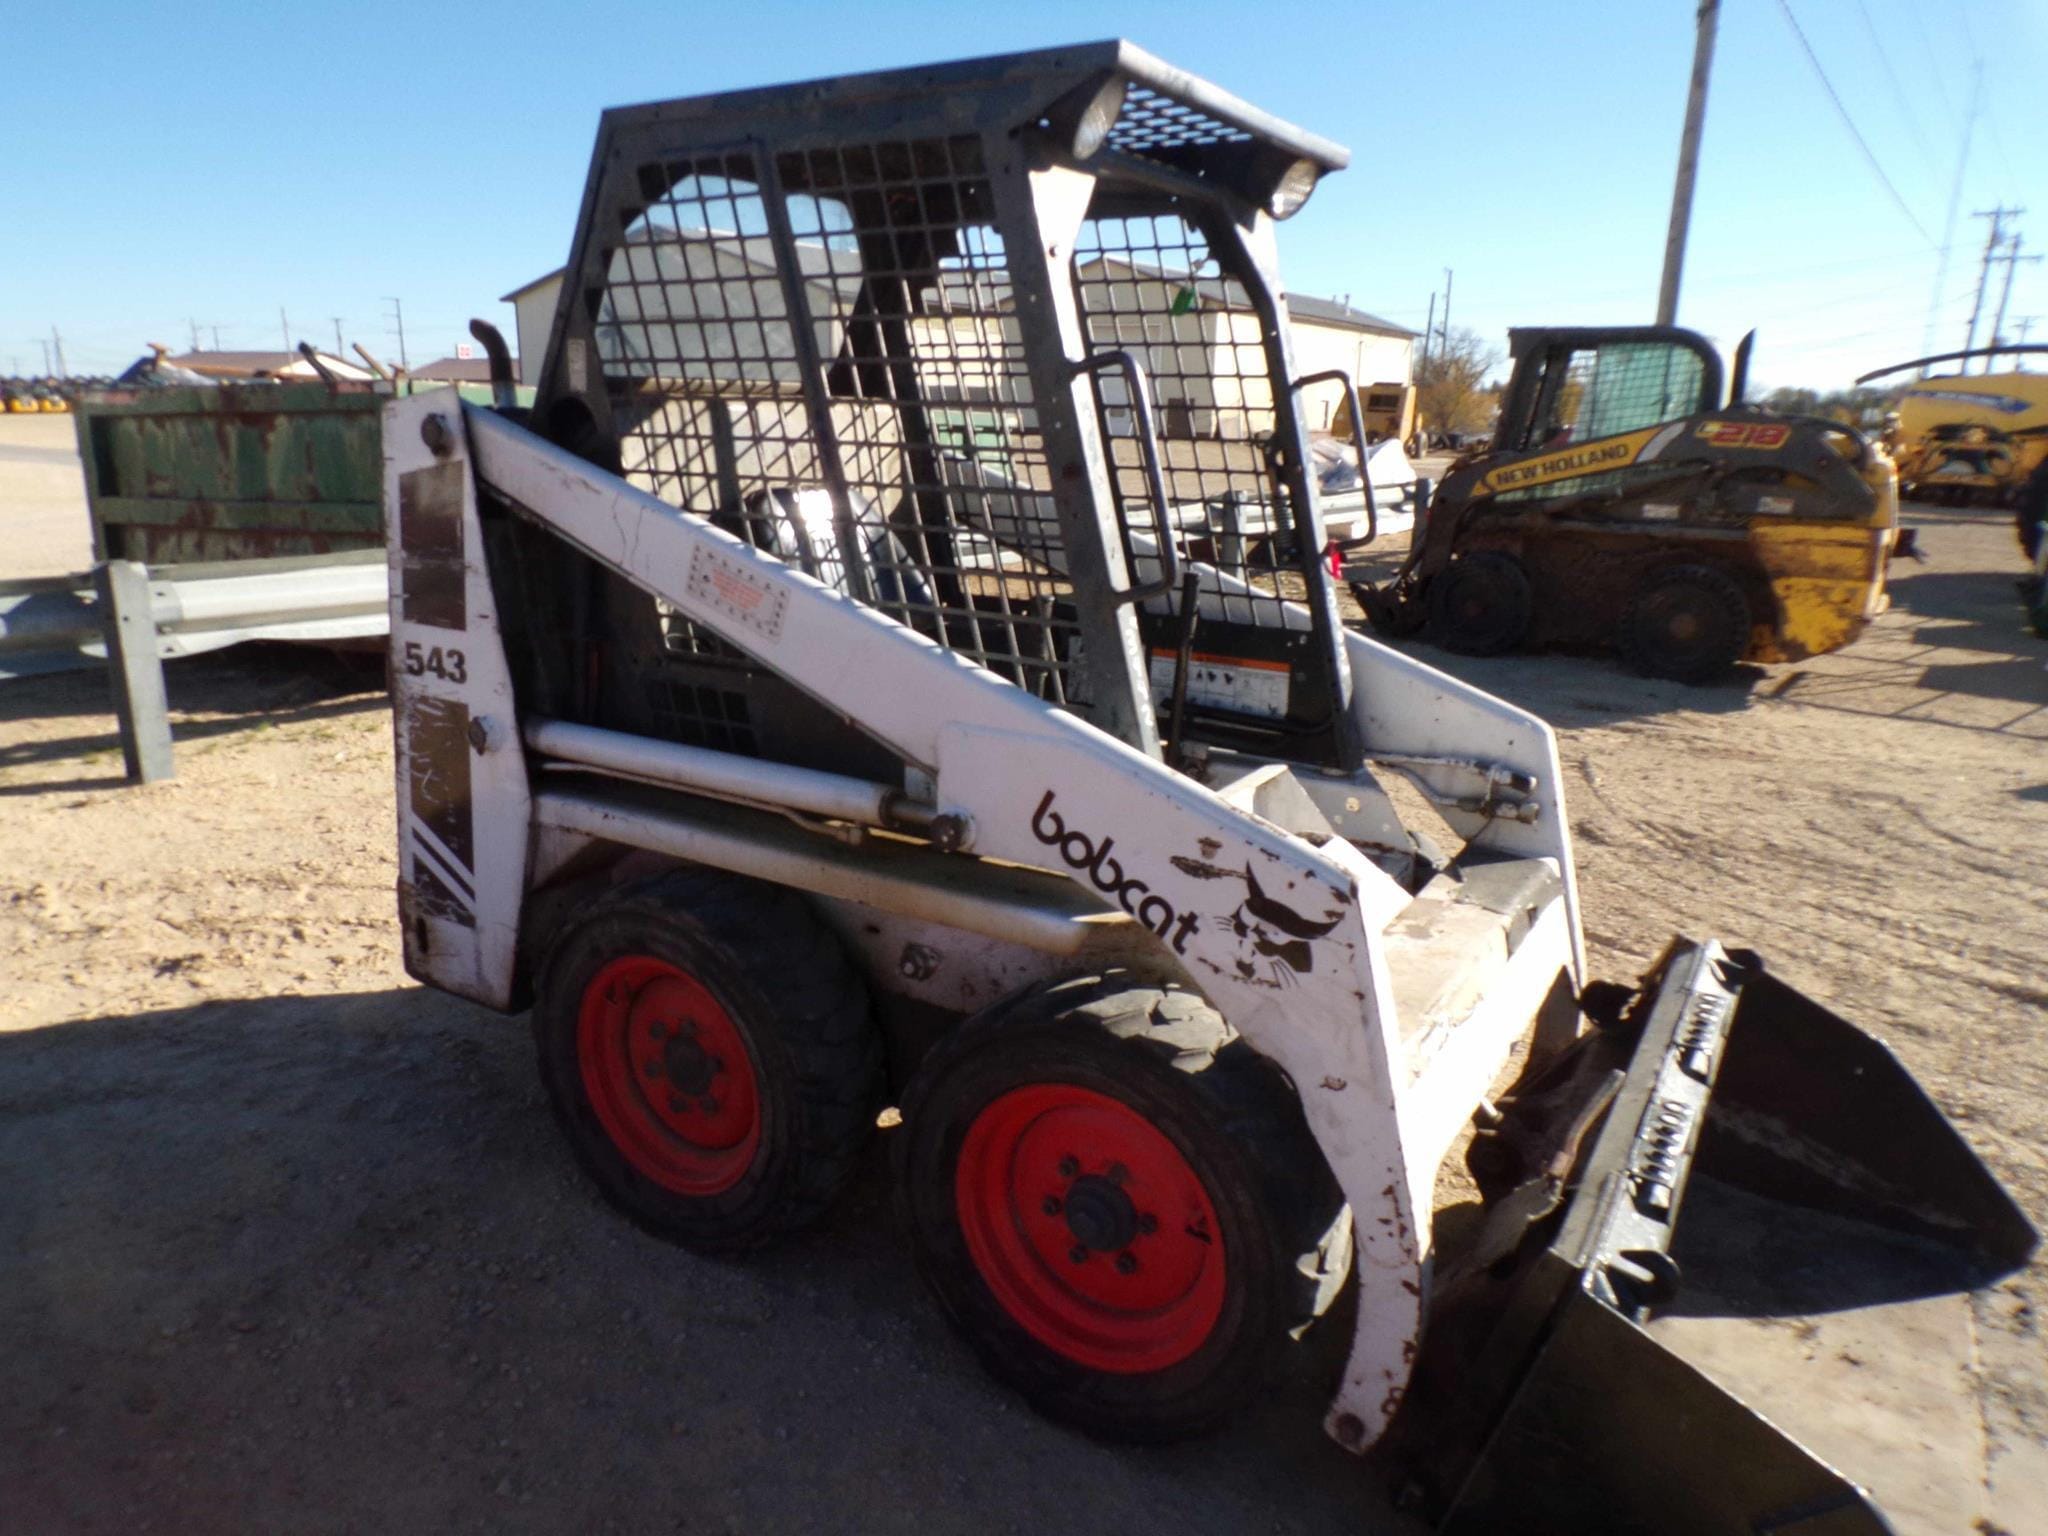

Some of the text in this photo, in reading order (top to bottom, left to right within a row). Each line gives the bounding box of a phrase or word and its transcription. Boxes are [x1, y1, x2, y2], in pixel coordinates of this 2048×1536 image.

[1496, 444, 1630, 485] NEW HOLLAND
[406, 641, 466, 683] 543
[1032, 790, 1199, 955] bobcat
